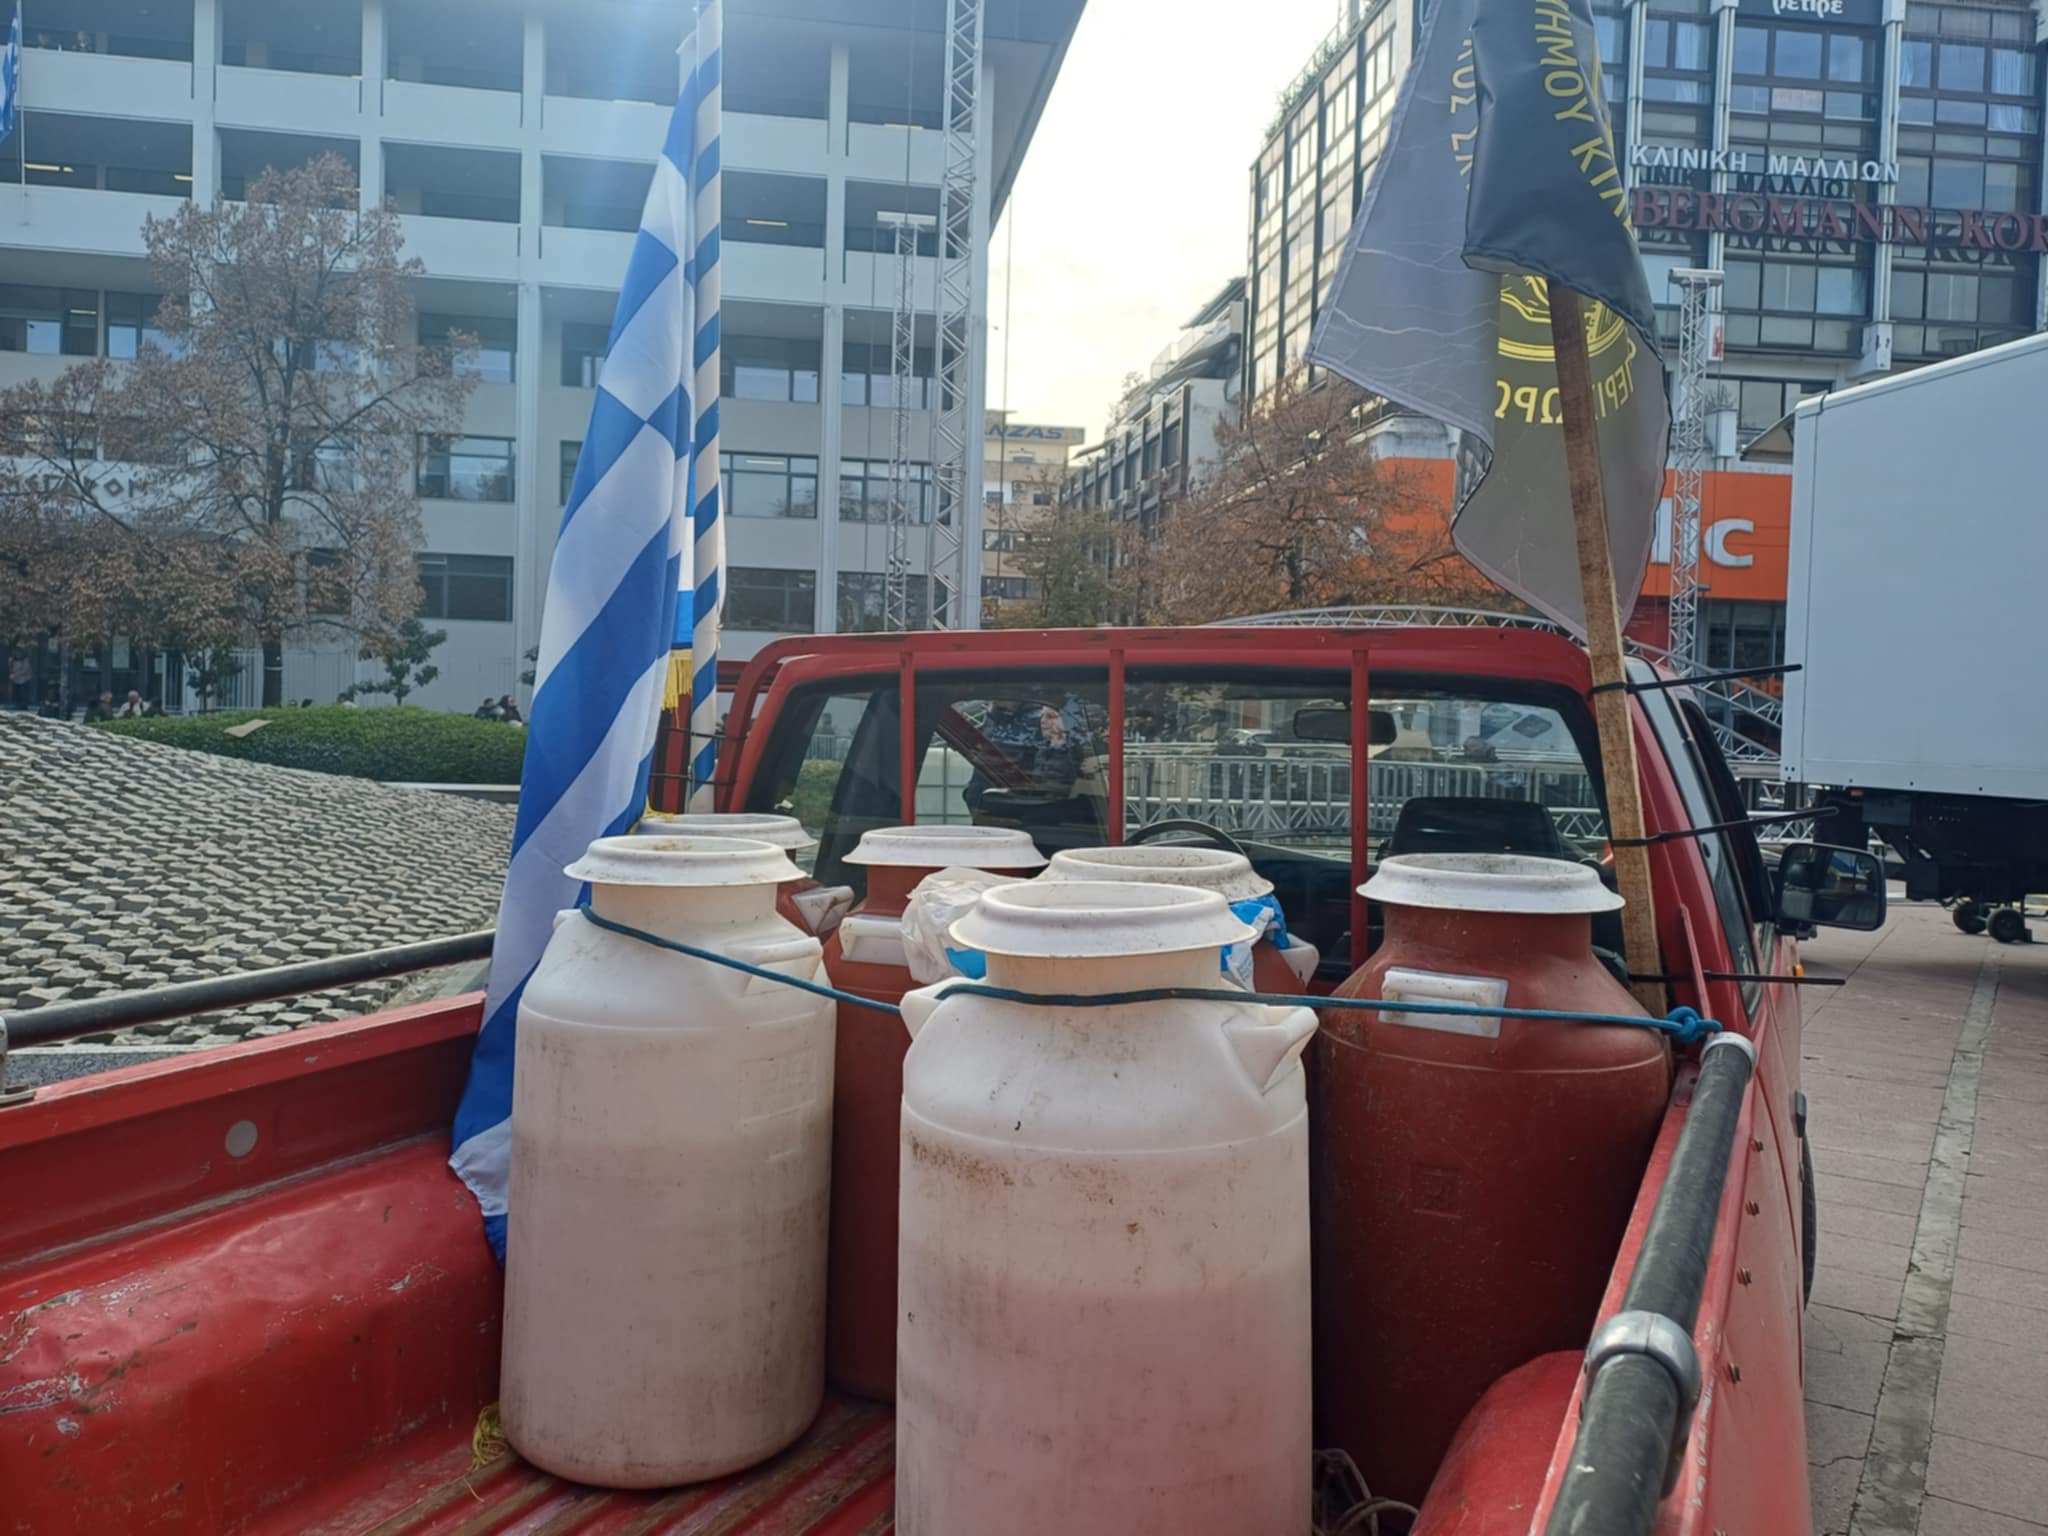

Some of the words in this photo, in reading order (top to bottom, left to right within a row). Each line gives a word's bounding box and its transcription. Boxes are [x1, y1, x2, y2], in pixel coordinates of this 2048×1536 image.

[1631, 145, 1747, 173] ΚΛΙΝΙΚΗ
[1768, 155, 1900, 183] ΜΑΛΛΙΩΝ
[1632, 187, 1927, 244] BERGMANN
